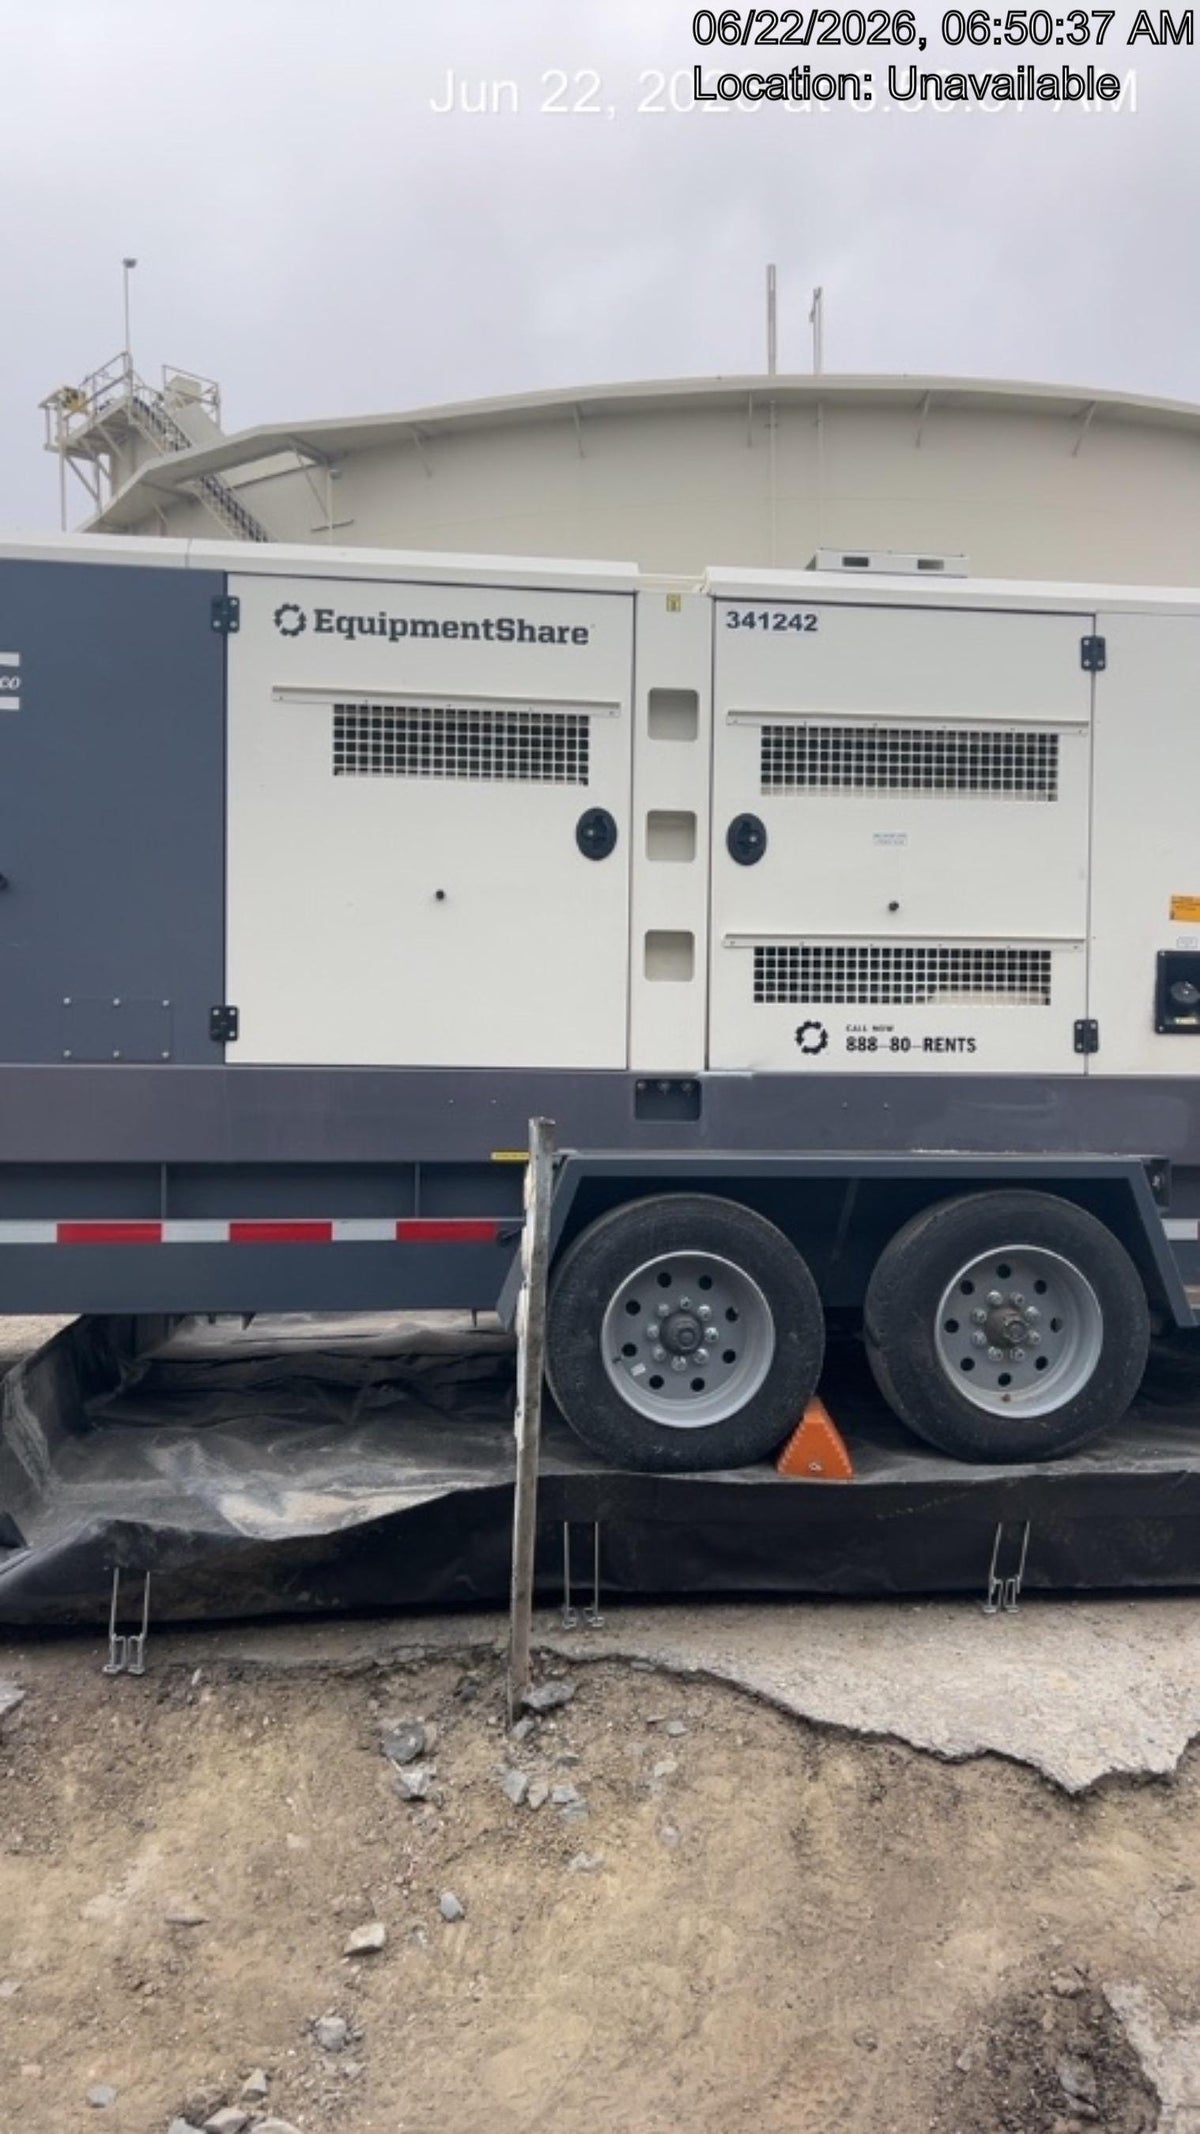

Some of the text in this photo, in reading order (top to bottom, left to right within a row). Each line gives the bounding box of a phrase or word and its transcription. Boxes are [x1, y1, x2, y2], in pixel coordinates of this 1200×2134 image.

[313, 608, 589, 645] EquipmentShare
[726, 611, 818, 631] 341242
[846, 1024, 867, 1032] CALL
